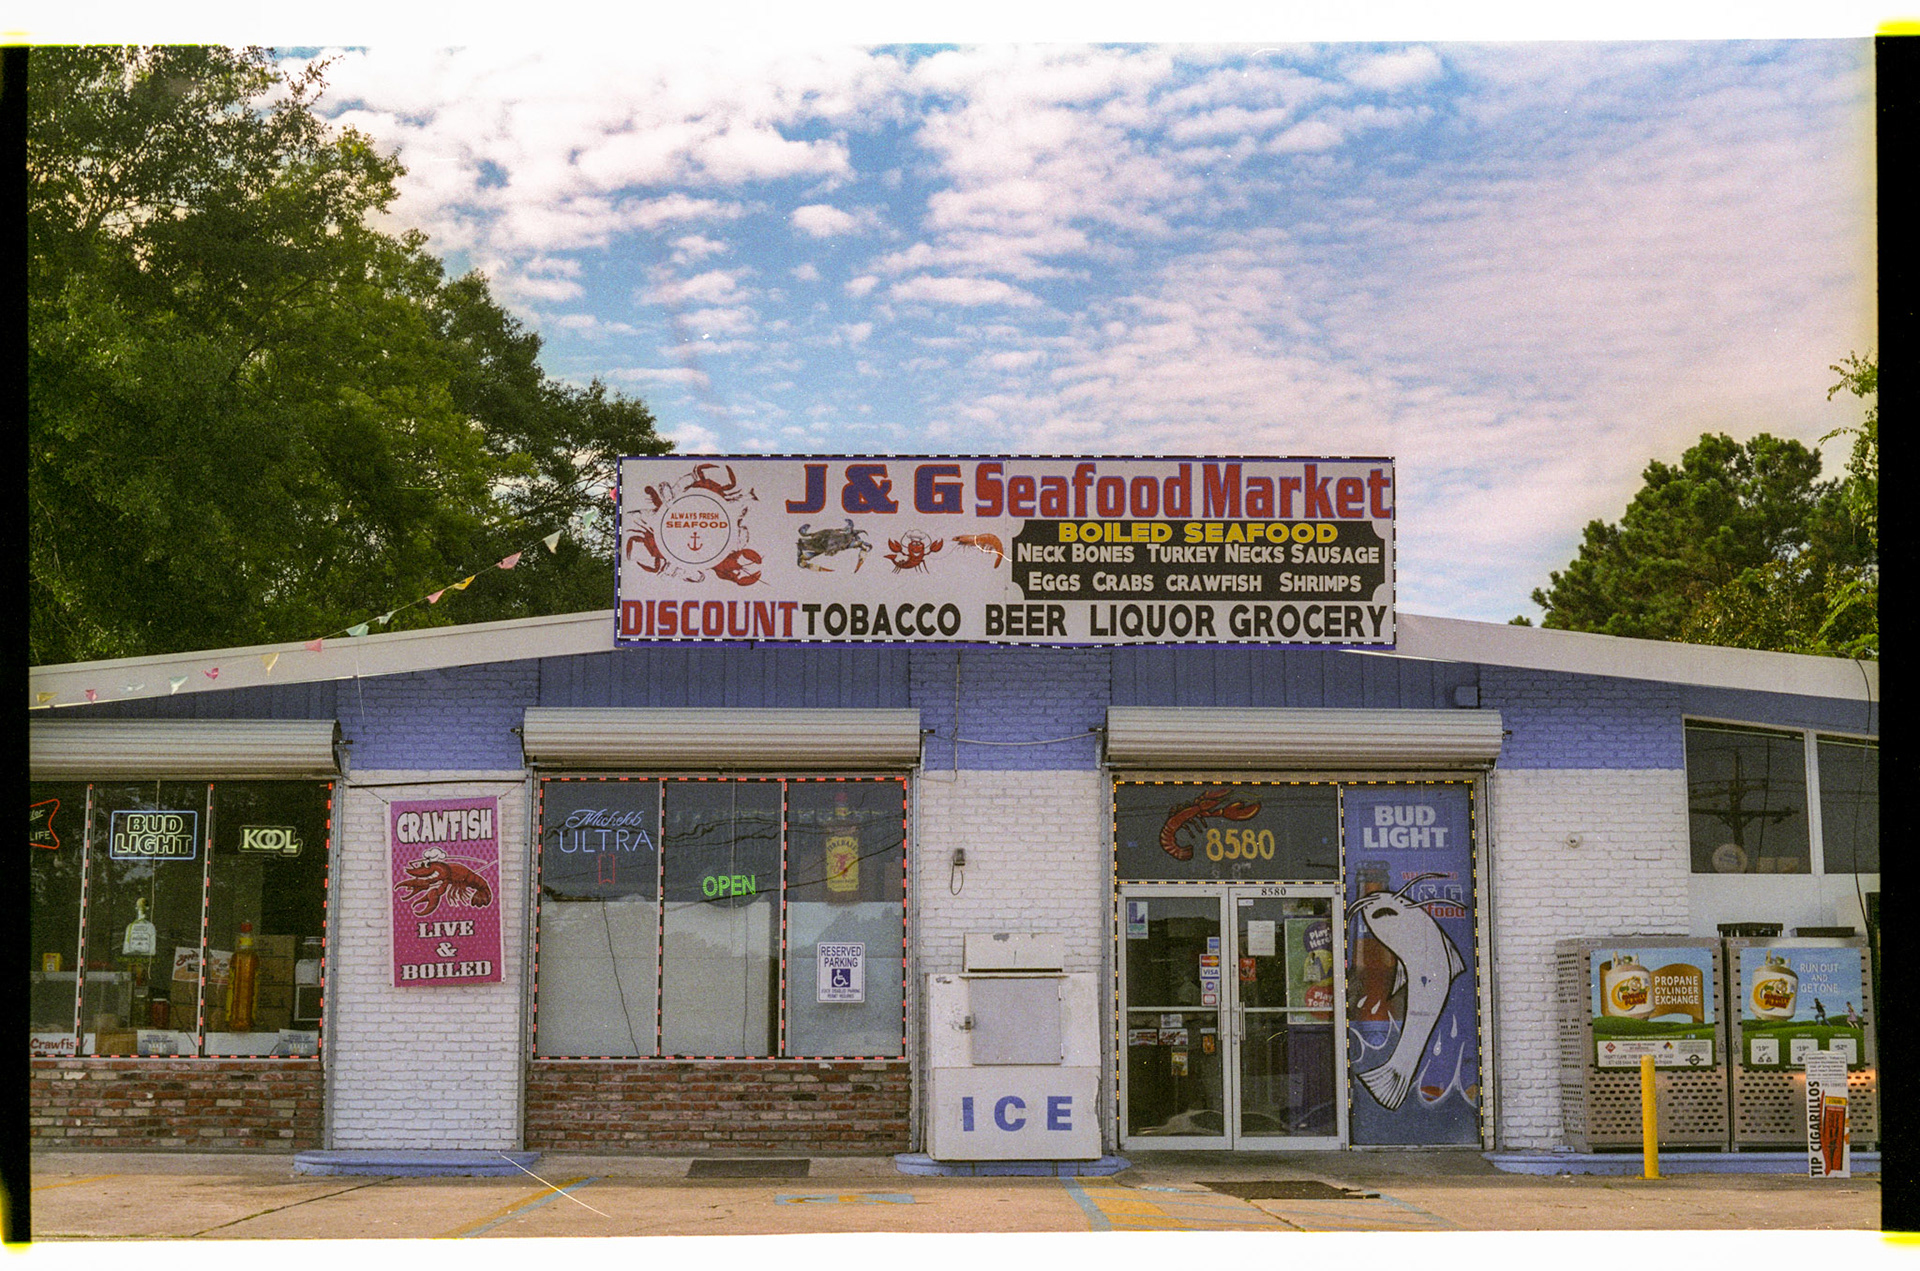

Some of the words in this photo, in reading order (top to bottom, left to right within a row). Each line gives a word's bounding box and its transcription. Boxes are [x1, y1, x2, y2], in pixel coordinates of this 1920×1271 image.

[785, 464, 829, 514] J
[841, 464, 899, 514] &
[914, 464, 964, 514] G
[975, 462, 1193, 518] Seafood
[1202, 462, 1393, 519] Market
[670, 512, 697, 520] ALWAYS
[699, 512, 719, 520] FRESH
[1058, 522, 1173, 543] BOILED
[1184, 522, 1339, 544] SEAFOOD
[1166, 574, 1262, 592] CRAWFISH
[621, 600, 798, 637] DISCOUNT
[802, 603, 961, 636] TOBACCO
[985, 604, 1067, 636] BEER
[1090, 604, 1216, 637] LIQUOR
[1229, 605, 1387, 638] GROCERY
[127, 814, 183, 834] BUD
[1374, 805, 1436, 826] BUD
[396, 808, 493, 844] CRAWFISH
[114, 834, 192, 854] LIGHT
[243, 829, 298, 849] KOOL
[559, 829, 654, 853] ULTRA
[1206, 828, 1275, 861] 8580
[1363, 826, 1449, 848] LIGHT
[702, 874, 756, 896] OPEN
[1261, 887, 1286, 897] 8580
[417, 920, 475, 938] LIVE
[435, 942, 458, 958] &
[820, 946, 862, 956] RESERVED
[401, 960, 493, 980] BOILED
[824, 957, 858, 967] PARKING
[1203, 968, 1219, 976] VISA
[1800, 963, 1818, 973] RUN
[1820, 963, 1839, 973] OUT
[1654, 976, 1699, 986] PROPANE
[1654, 986, 1699, 995] CYLINDER
[1801, 983, 1819, 993] GET
[1654, 995, 1699, 1005] EXCHANGE
[30, 1038, 76, 1049] Crawfis
[962, 1095, 1073, 1132] ICE
[1808, 1081, 1822, 1152] CIGARILLOS
[1811, 1156, 1823, 1176] TIP
